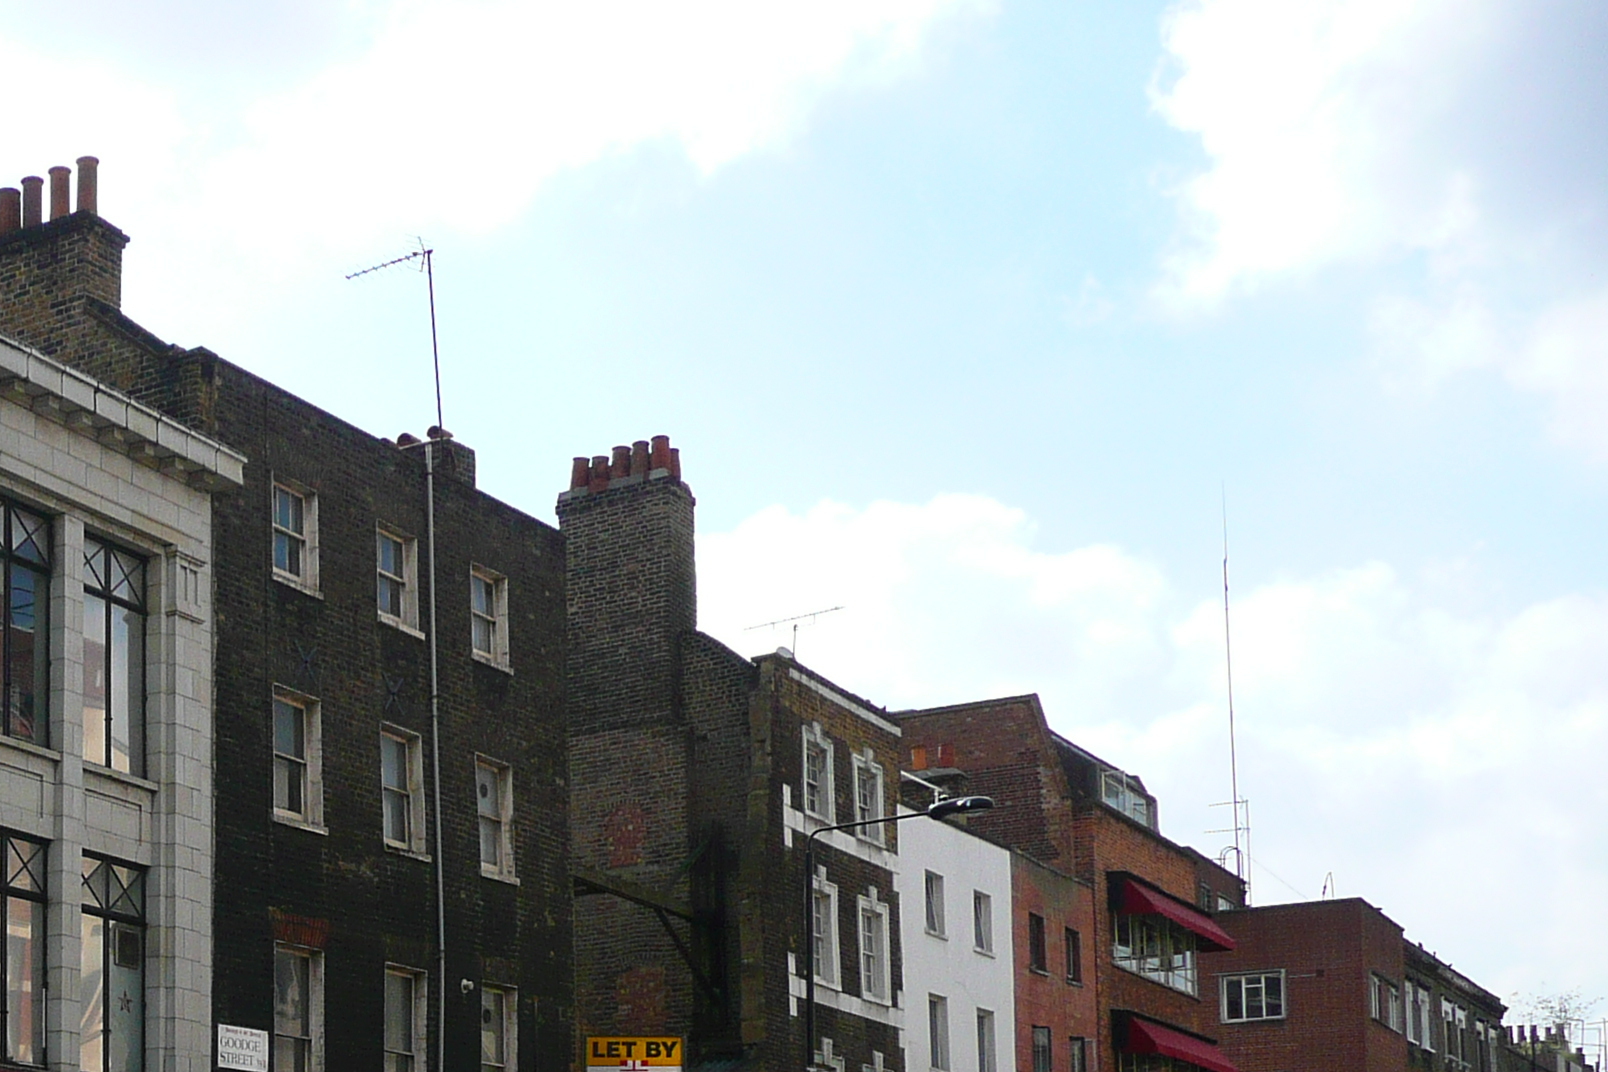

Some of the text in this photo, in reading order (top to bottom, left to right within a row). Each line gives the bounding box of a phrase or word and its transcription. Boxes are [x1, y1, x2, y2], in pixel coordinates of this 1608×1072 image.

[220, 1036, 262, 1053] GOODGE
[592, 1041, 678, 1058] LET BY
[220, 1051, 255, 1066] STREET
